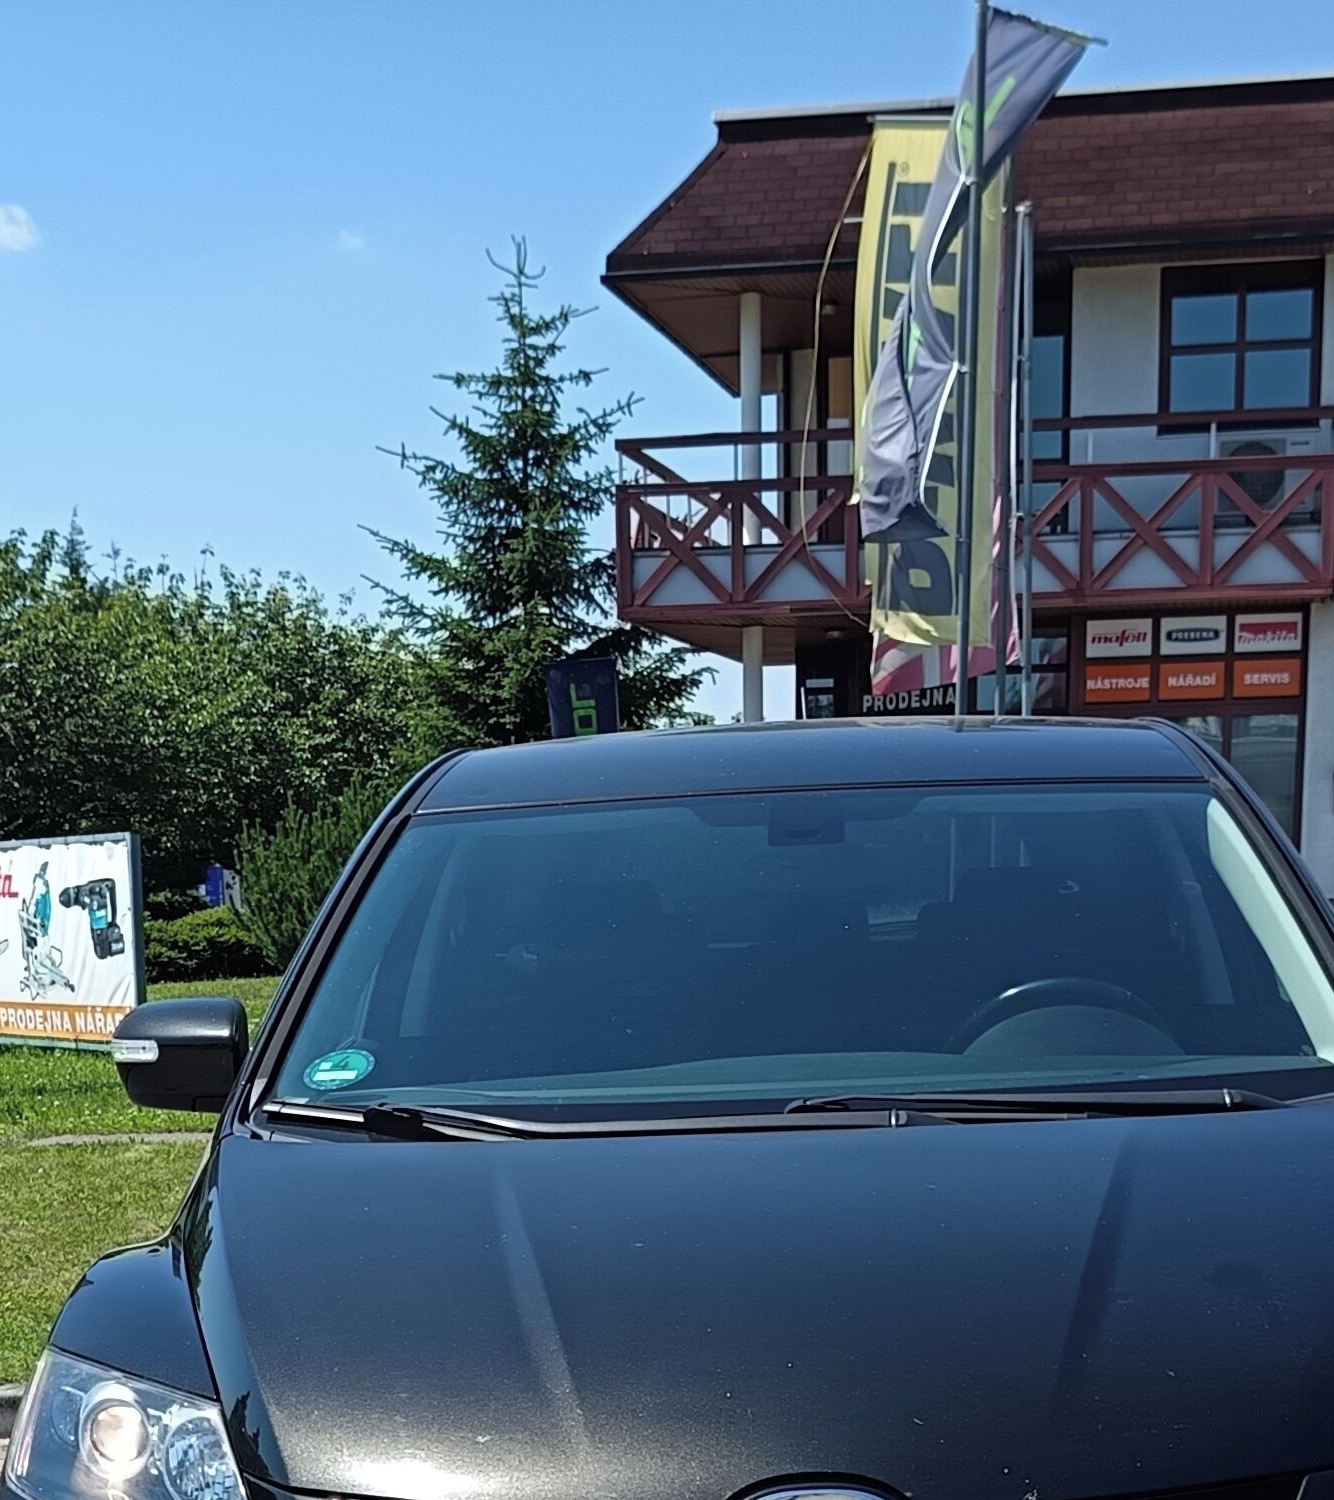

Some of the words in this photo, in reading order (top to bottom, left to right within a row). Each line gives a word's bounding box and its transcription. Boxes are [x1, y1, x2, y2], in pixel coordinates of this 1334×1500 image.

[1086, 676, 1150, 690] NÁSTROJE
[1168, 672, 1217, 687] NÁŘADÍ
[1243, 672, 1291, 685] SERVIS
[862, 686, 958, 713] PRODEJNA
[0, 1007, 73, 1034] PRODEJNA
